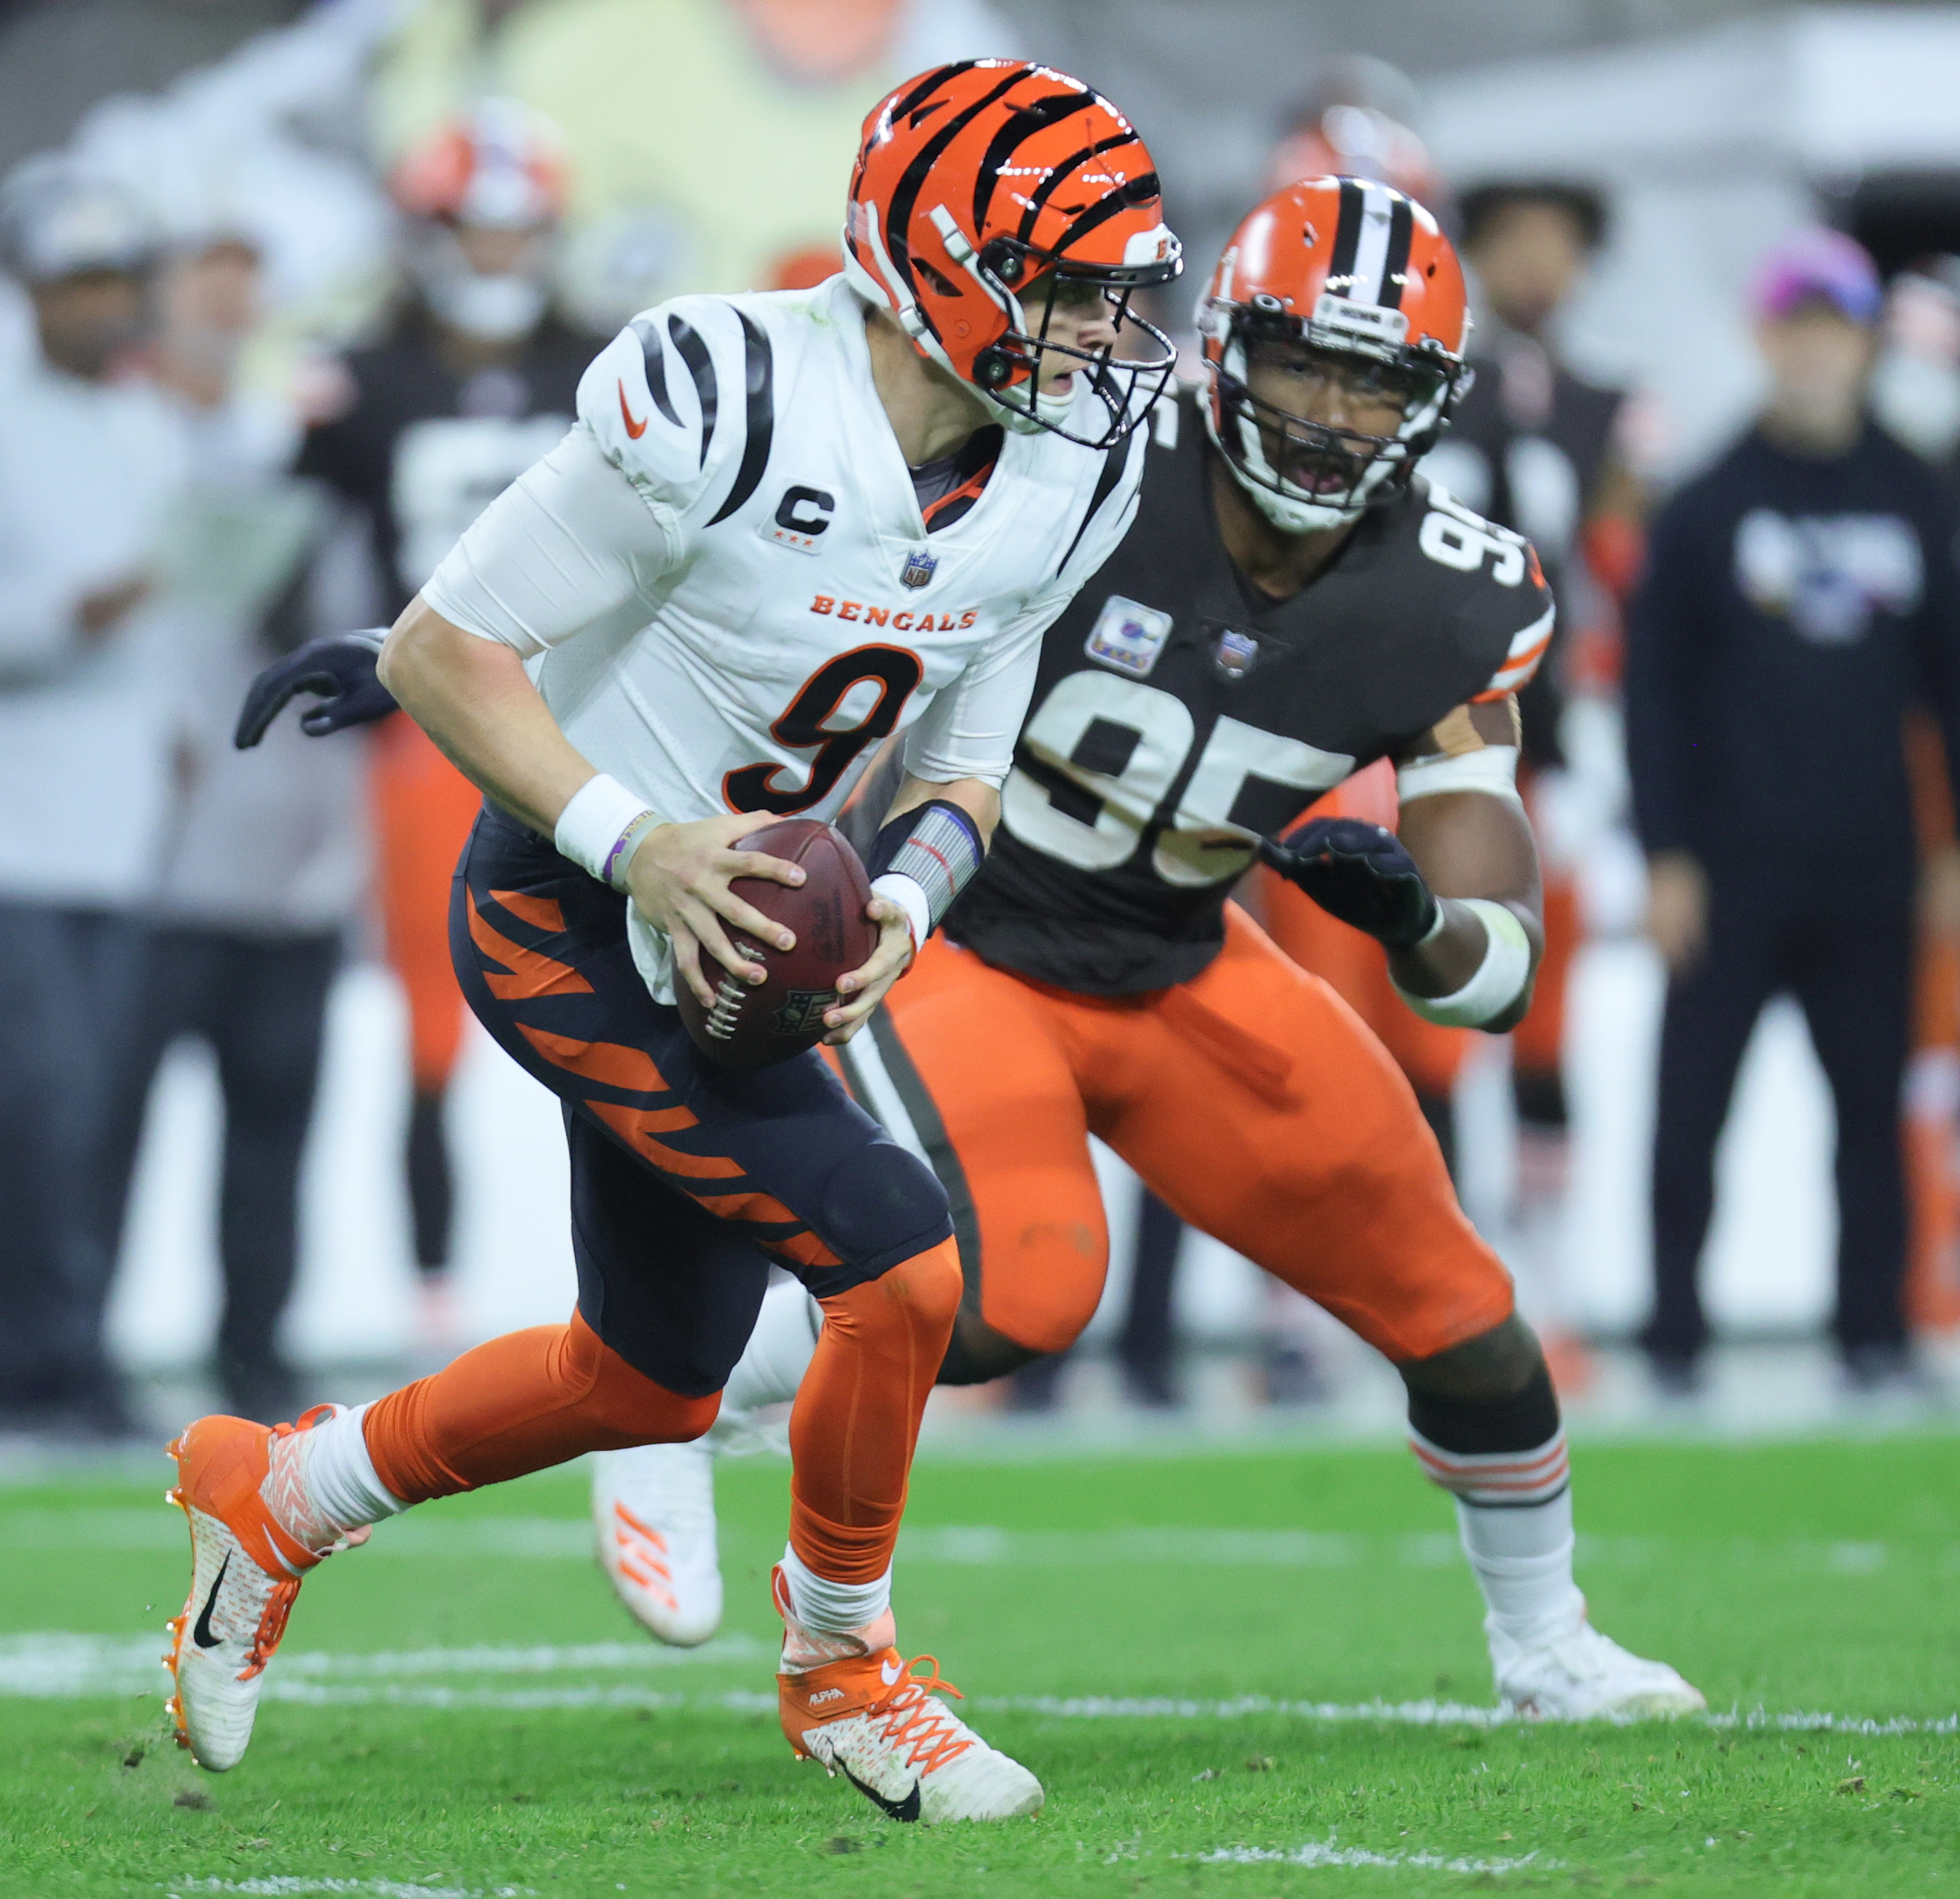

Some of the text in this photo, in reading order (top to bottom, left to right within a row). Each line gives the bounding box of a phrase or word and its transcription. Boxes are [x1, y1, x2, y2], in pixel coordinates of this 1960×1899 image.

[775, 484, 836, 536] C
[810, 595, 978, 633] BENGALS
[723, 642, 924, 815] 9
[1000, 670, 1357, 887] 95
[809, 1688, 845, 1706] ALPHA
